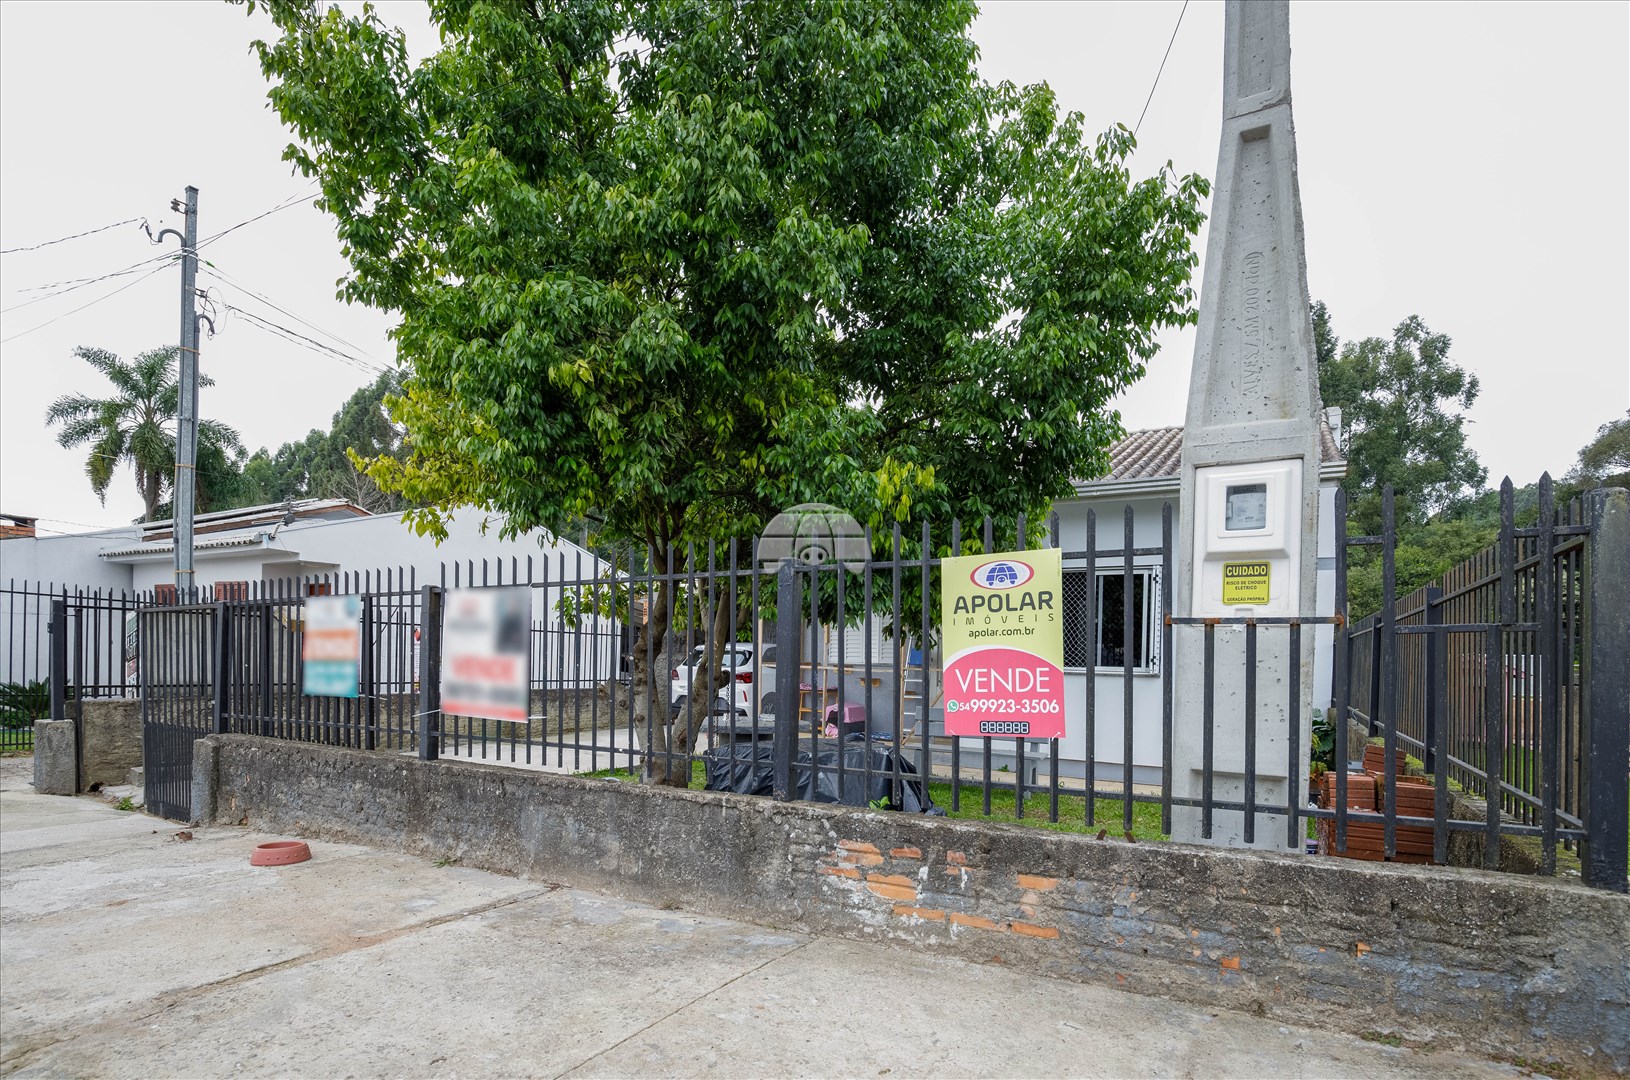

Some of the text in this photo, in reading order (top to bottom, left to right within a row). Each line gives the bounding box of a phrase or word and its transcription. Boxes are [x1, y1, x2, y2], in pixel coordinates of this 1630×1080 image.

[1226, 565, 1267, 576] CUIDADO
[953, 591, 1054, 614] APOLAR
[968, 626, 1036, 639] apolar.com.br
[955, 667, 1051, 694] VENDE
